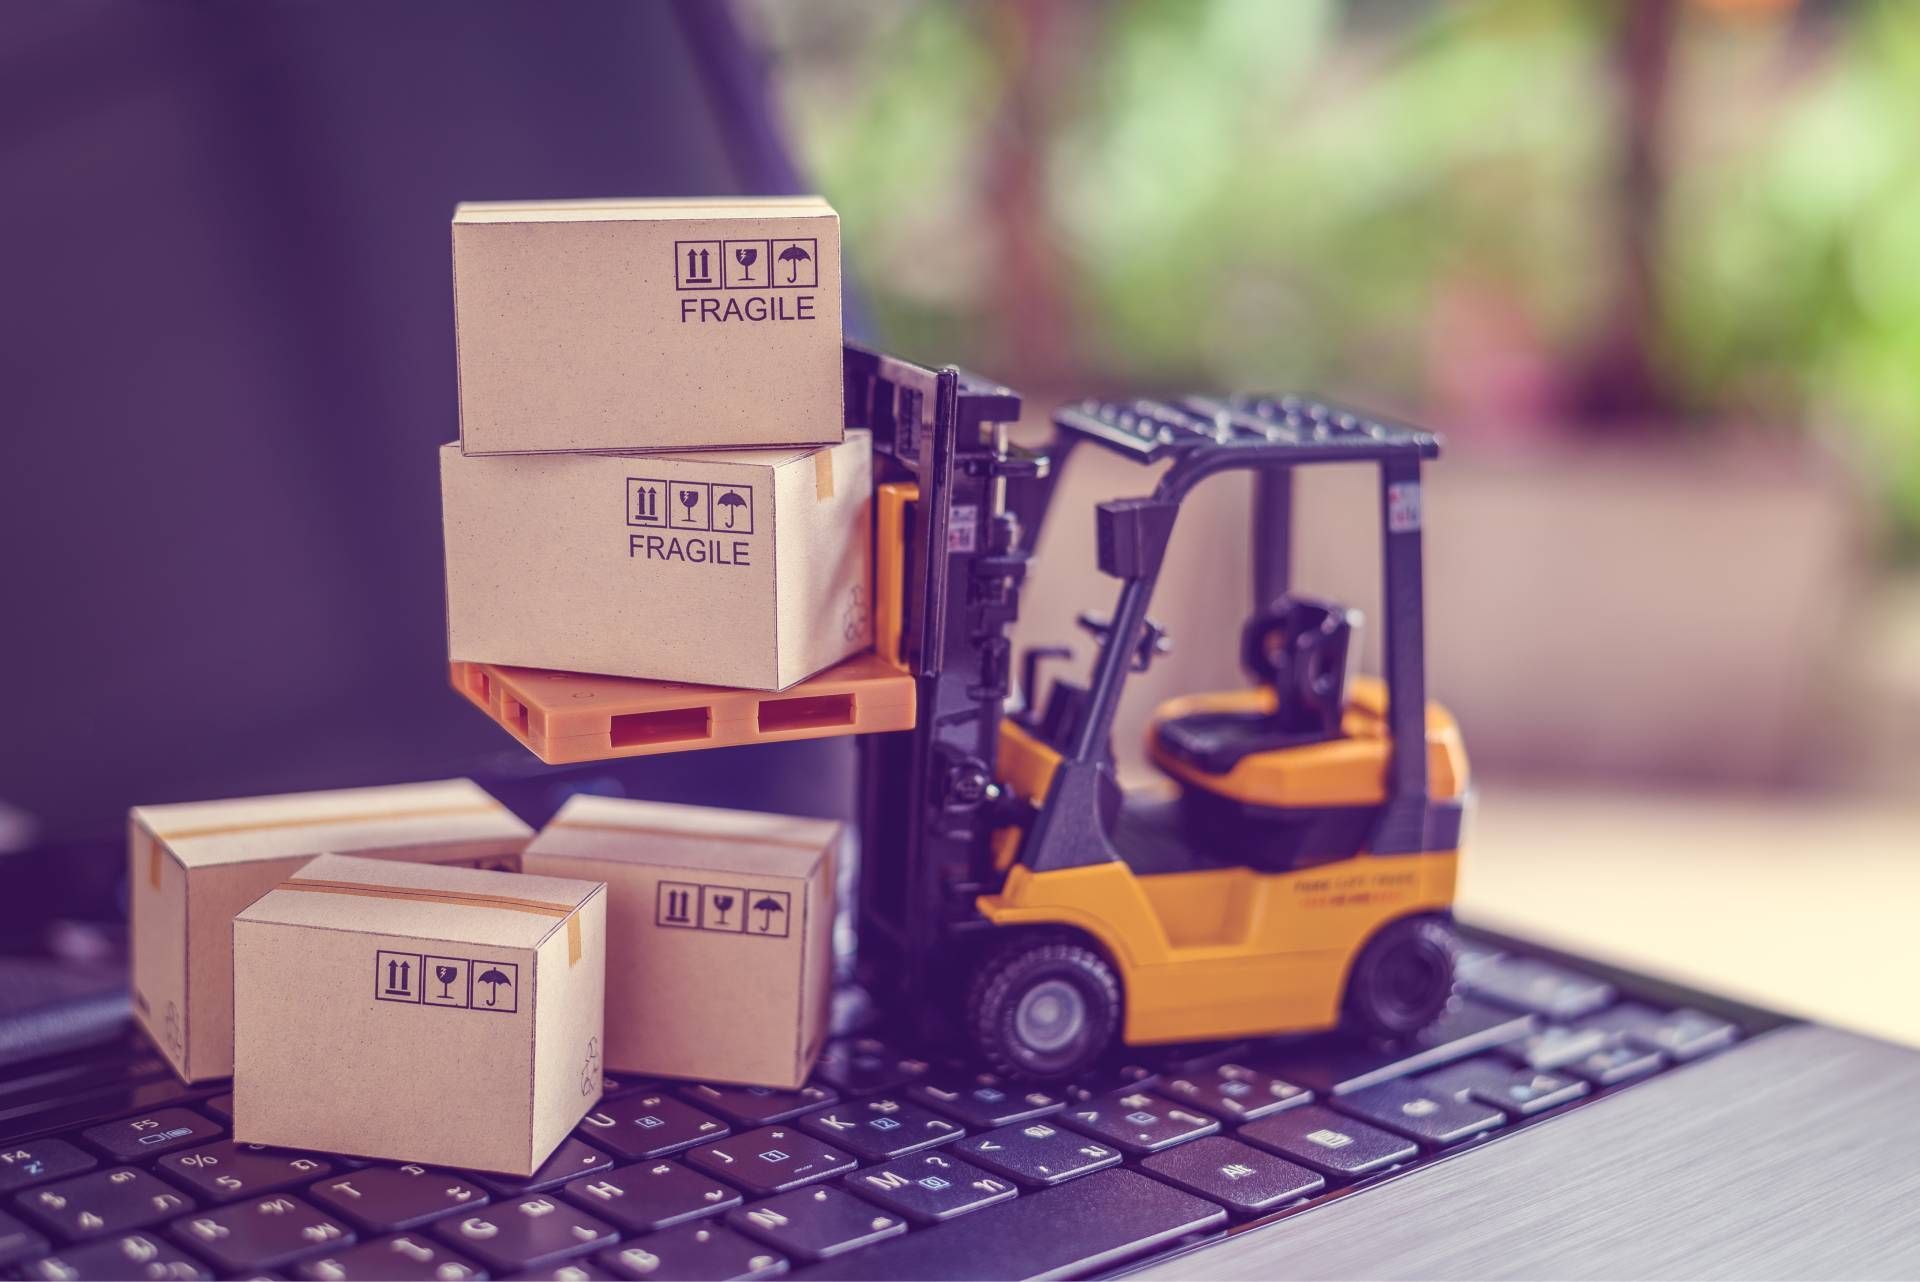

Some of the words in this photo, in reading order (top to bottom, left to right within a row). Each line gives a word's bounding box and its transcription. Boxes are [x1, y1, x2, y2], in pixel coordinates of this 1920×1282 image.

[680, 295, 816, 323] FRAGILE
[628, 534, 751, 566] FRAGILE
[131, 1120, 159, 1130] F5
[585, 1112, 616, 1127] U
[820, 1115, 855, 1130] K
[1, 1150, 32, 1163] F4
[181, 1154, 218, 1167] %
[712, 1150, 733, 1163] J
[926, 1157, 948, 1167] ?
[1222, 1165, 1256, 1179] Alt
[216, 1176, 242, 1188] 5
[866, 1172, 909, 1190] M
[333, 1182, 361, 1196] T
[587, 1182, 623, 1199] H
[748, 1208, 788, 1229] N
[462, 1218, 498, 1236] G
